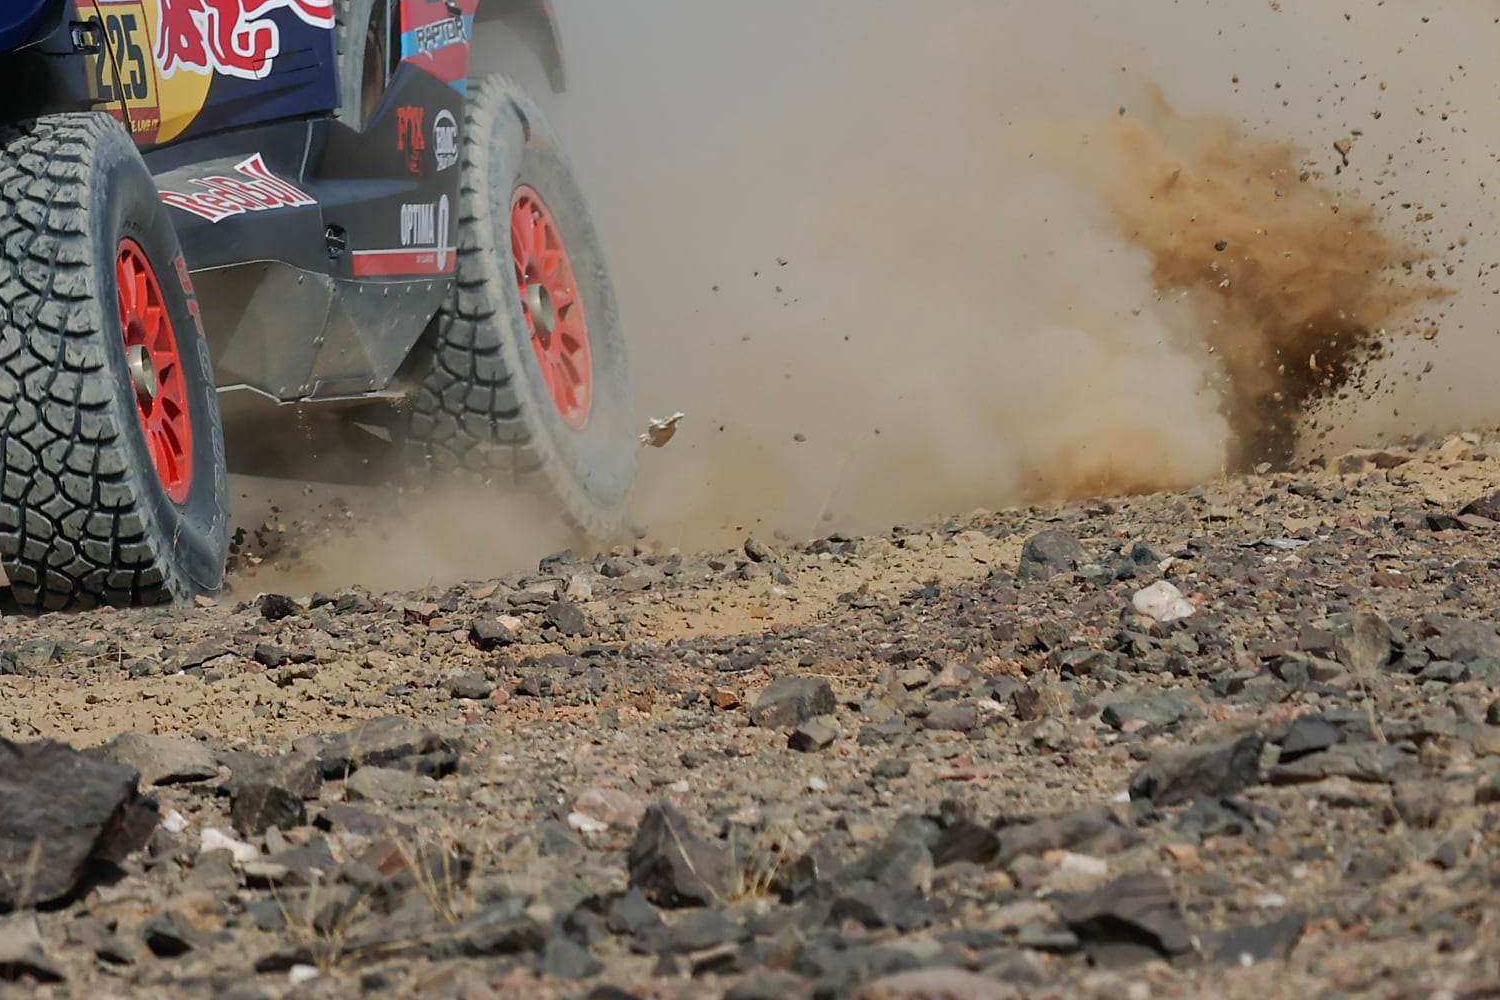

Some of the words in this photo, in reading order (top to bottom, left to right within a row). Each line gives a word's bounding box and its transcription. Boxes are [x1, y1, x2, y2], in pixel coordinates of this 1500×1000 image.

[89, 14, 148, 100] 225
[414, 16, 469, 56] RAPTOR
[157, 177, 269, 224] Red
[202, 152, 318, 209] Bull
[400, 203, 435, 247] OPTIMA
